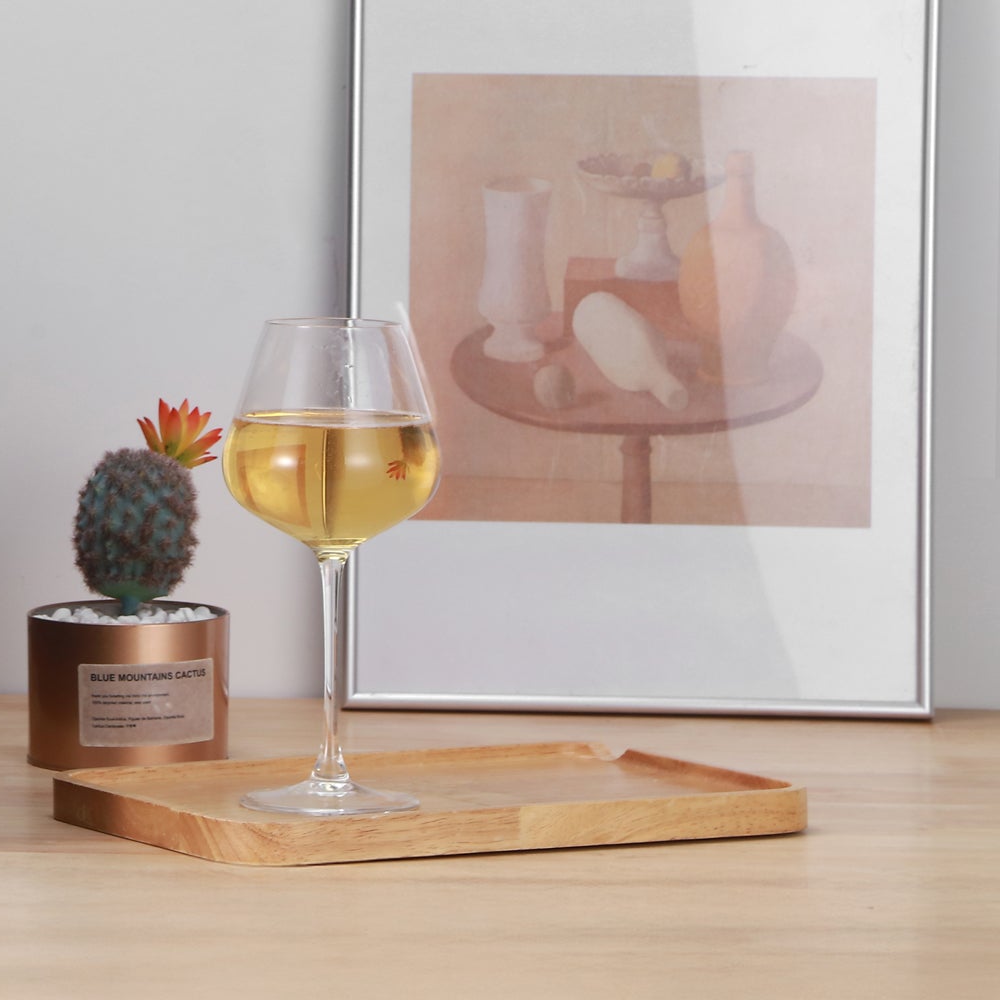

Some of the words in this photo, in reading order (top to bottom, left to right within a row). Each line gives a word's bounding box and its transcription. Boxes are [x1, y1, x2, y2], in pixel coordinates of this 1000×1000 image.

[90, 673, 115, 682] BLUE
[118, 672, 173, 682] MOUNTAINS
[175, 668, 206, 680] CACTUS
